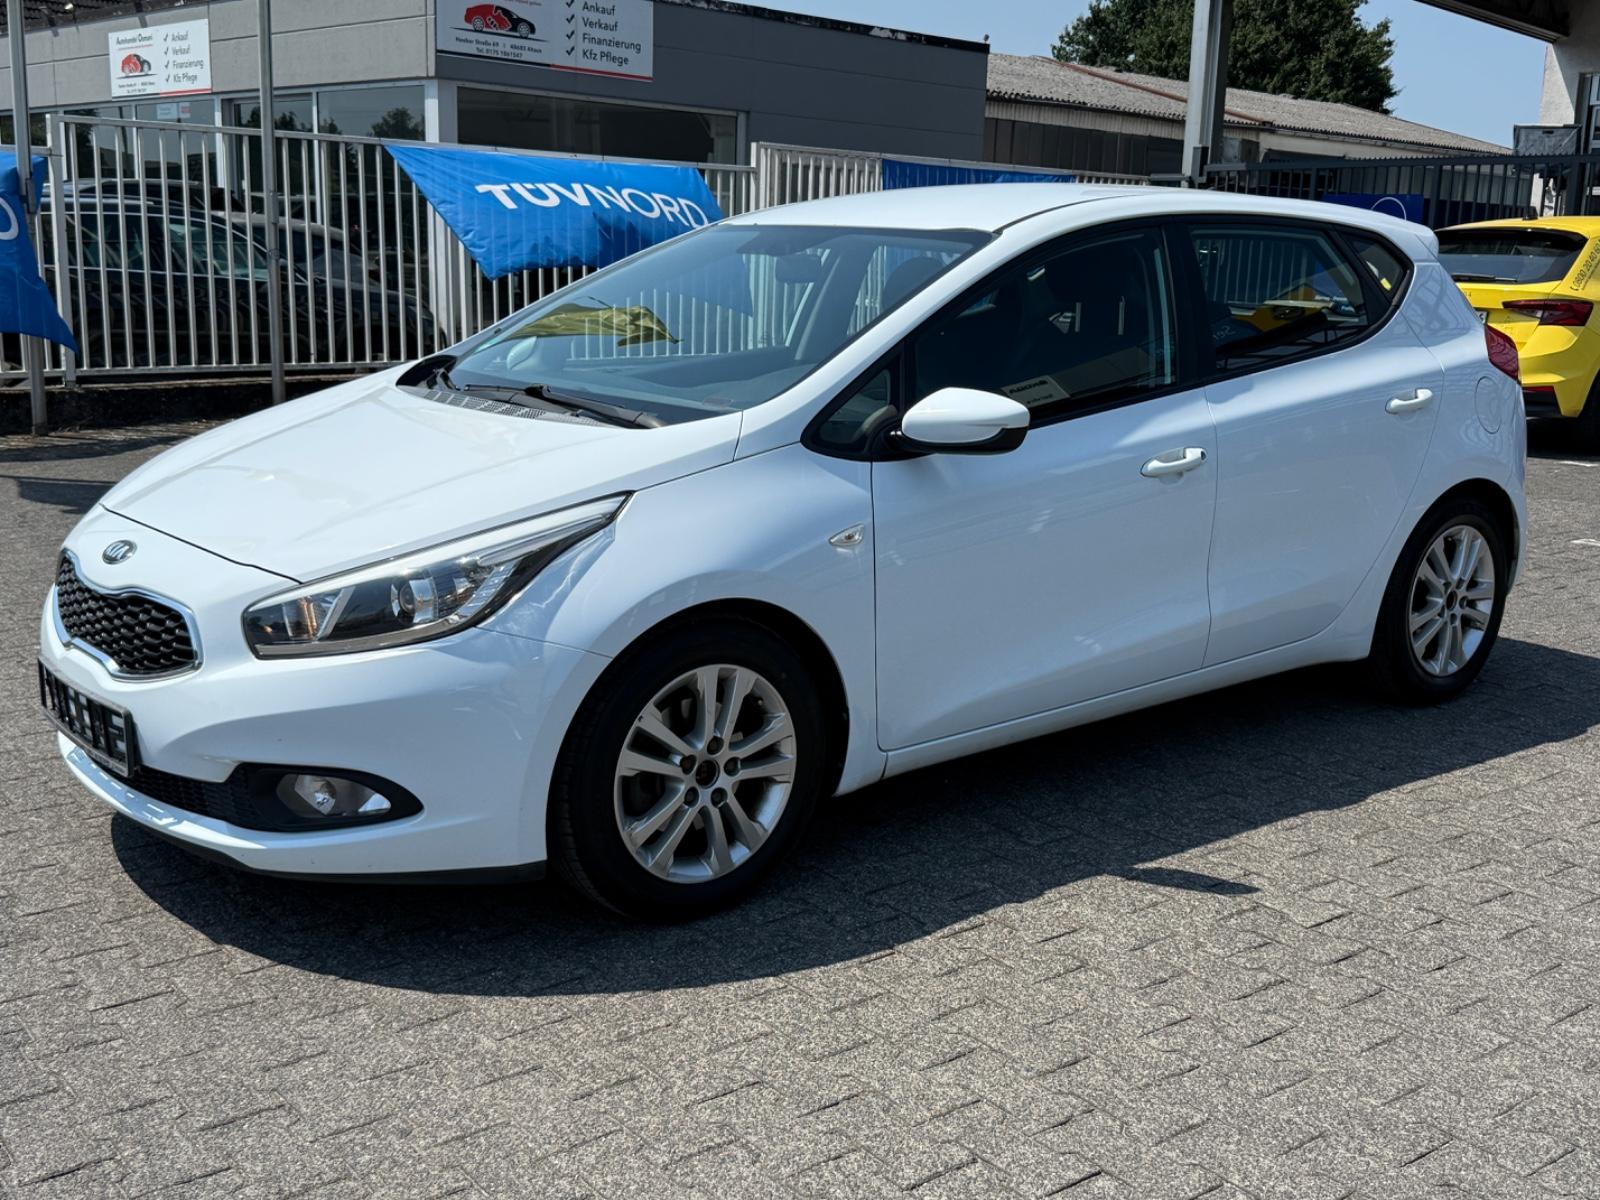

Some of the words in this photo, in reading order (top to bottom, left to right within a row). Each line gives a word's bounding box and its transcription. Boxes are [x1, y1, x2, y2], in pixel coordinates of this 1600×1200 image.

[582, 1, 616, 16] Ankauf
[582, 16, 618, 31] Verkauf
[171, 31, 189, 41] Ankauf
[582, 32, 641, 54] Finanzierung
[172, 44, 190, 56] Verkauf
[173, 59, 204, 70] Finanzierung
[582, 49, 598, 61] Kfz
[600, 50, 629, 67] Pflege
[182, 73, 197, 84] Pflege
